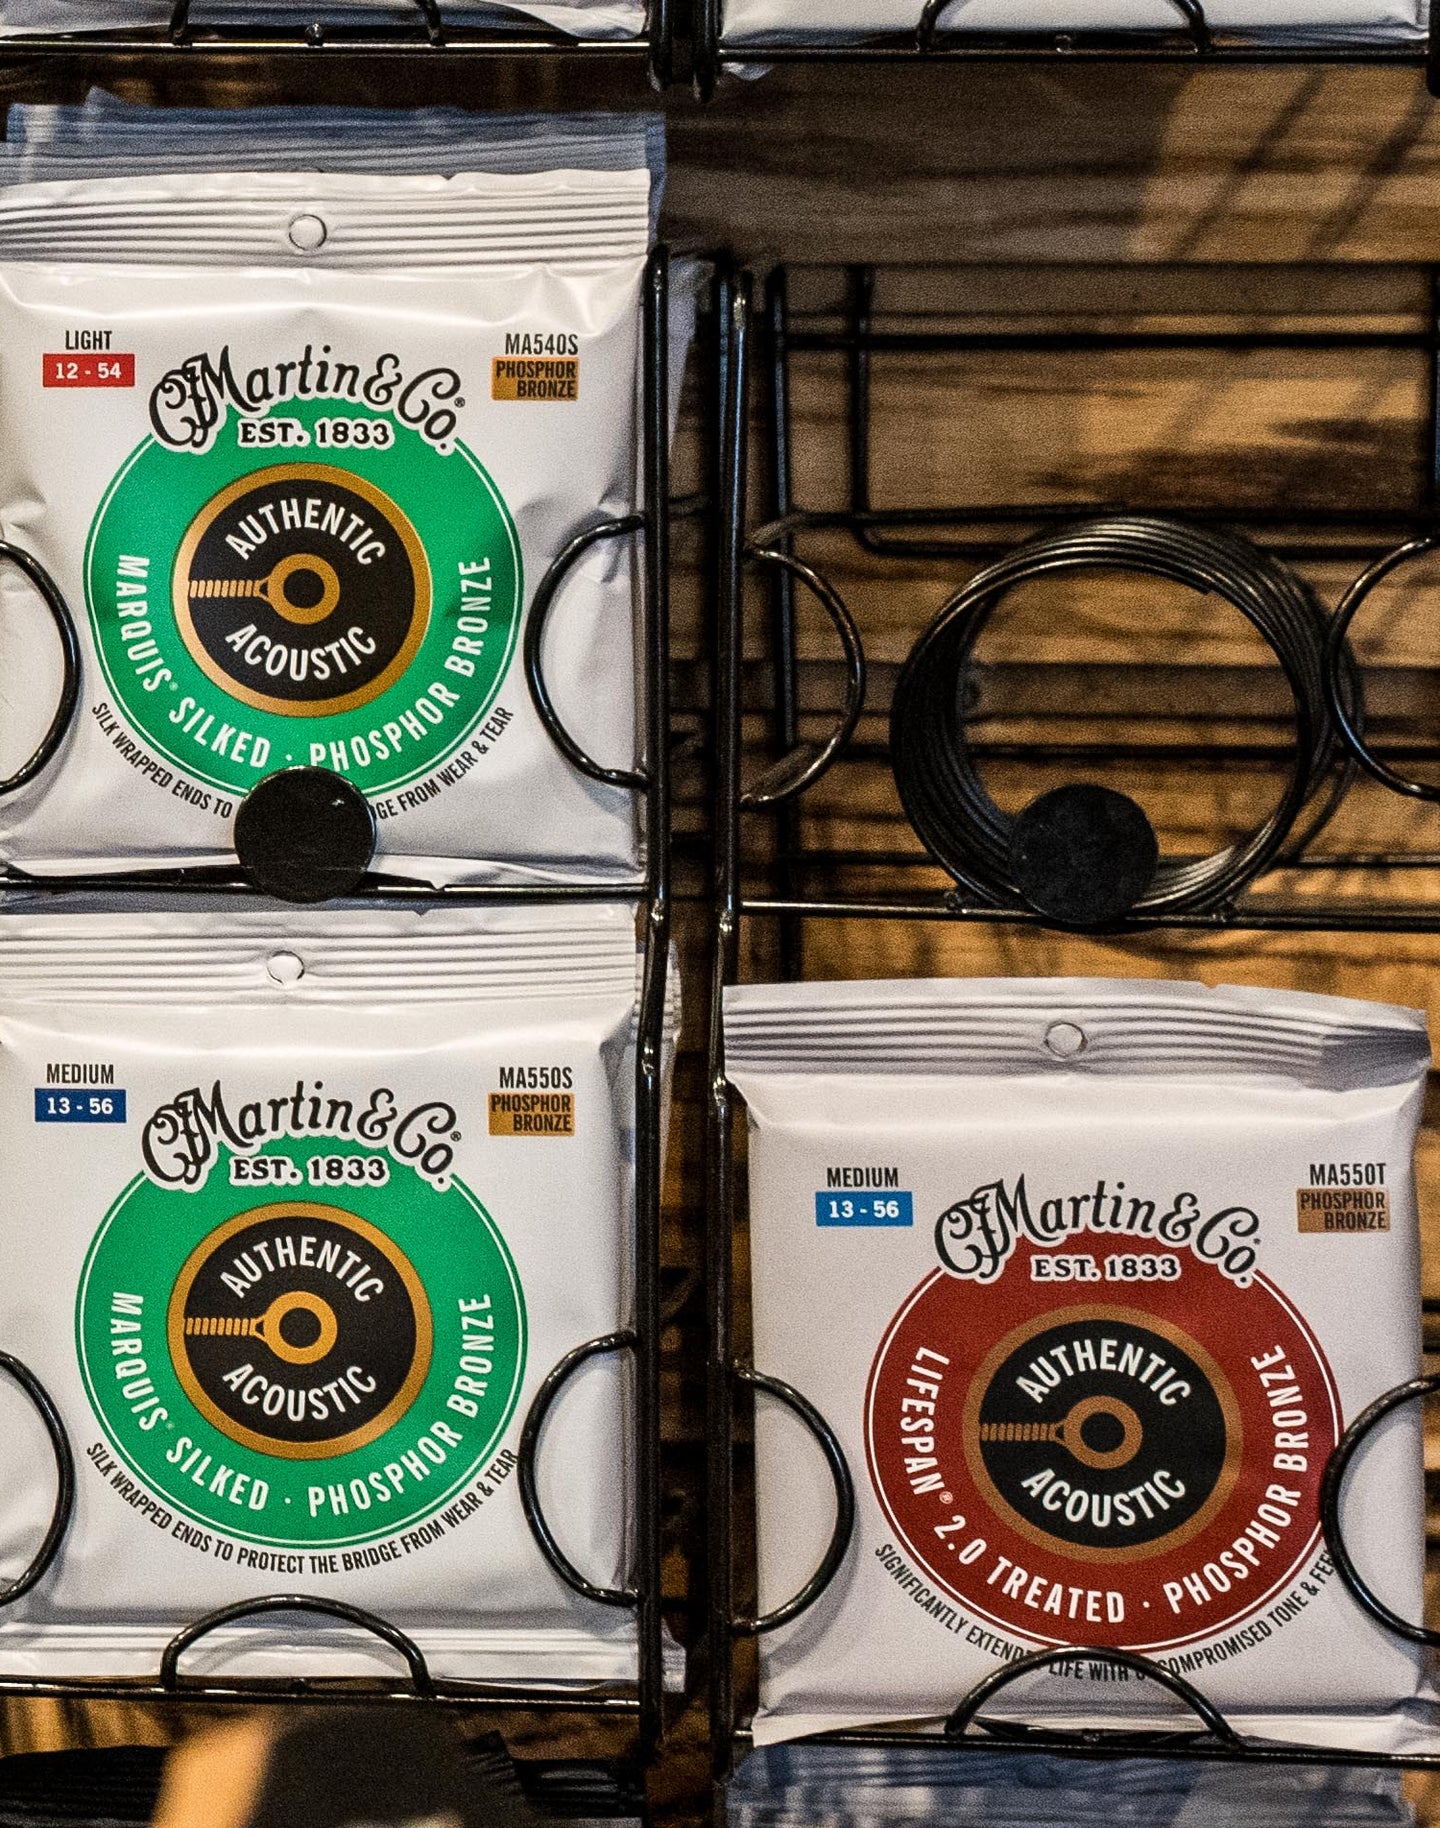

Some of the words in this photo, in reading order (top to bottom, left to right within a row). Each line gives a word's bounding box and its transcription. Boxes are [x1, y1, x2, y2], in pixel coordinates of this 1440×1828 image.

[65, 330, 113, 350] LIGHT
[505, 333, 579, 356] MA540S
[55, 362, 78, 380] 12
[98, 362, 122, 380] 54
[495, 360, 577, 379] PHOSPHOR
[516, 379, 577, 398] BRONZE
[240, 421, 305, 444] EST.
[318, 421, 390, 445] 1833
[225, 498, 385, 565] AUTHENTIC
[225, 623, 376, 681] ACOUSTIC
[169, 697, 271, 768] SILKED
[309, 681, 460, 773] PHOSPHOR
[444, 556, 492, 678] BRONZE
[91, 702, 120, 737] SILK
[112, 731, 173, 788] WRAPPED
[171, 779, 212, 810] ENDS
[212, 798, 233, 819] TO
[396, 778, 442, 812] FROM
[436, 750, 478, 787] WEAR
[480, 706, 514, 742] TEAR
[46, 1063, 114, 1085] MEDIUM
[499, 1067, 573, 1089] MA550S
[47, 1098, 70, 1115] 13
[88, 1098, 114, 1115] 56
[491, 1094, 572, 1114] PHOSPHOR
[513, 1114, 572, 1133] BRONZE
[233, 1158, 298, 1180] EST.
[310, 1158, 386, 1181] 1833
[827, 1167, 899, 1188] MEDIUM
[1309, 1163, 1386, 1186] MA550T
[829, 1201, 853, 1219] 13
[873, 1201, 899, 1219] 56
[1300, 1191, 1385, 1210] PHOSPHOR
[1324, 1211, 1386, 1230] BRONZE
[219, 1236, 384, 1303] AUTHENTIC
[1034, 1257, 1099, 1279] EST.
[1107, 1256, 1178, 1279] 1833
[1015, 1338, 1191, 1406] AUTHENTIC
[222, 1363, 377, 1422] ACOUSTIC
[166, 1437, 269, 1511] SILKED
[308, 1420, 463, 1517] PHOSPHOR
[447, 1294, 495, 1419] BRONZE
[87, 1442, 118, 1477] SILK
[484, 1448, 518, 1485] TEAR
[476, 1481, 494, 1497] &
[934, 1514, 987, 1567] 2.0
[986, 1555, 1125, 1623] TREATED
[1163, 1483, 1302, 1614] PHOSPHOR
[1251, 1343, 1309, 1474] BRONZE
[110, 1471, 173, 1530] WRAPPED
[441, 1491, 483, 1528] WEAR
[1021, 1467, 1187, 1528] ACOUSTIC
[171, 1520, 212, 1552] ENDS
[400, 1519, 445, 1553] FROM
[214, 1539, 233, 1561] TO
[237, 1547, 305, 1574] PROTECT
[342, 1540, 402, 1571] BRIDGE
[309, 1555, 339, 1574] THE
[875, 1543, 967, 1634] SIGNIFICANTLY
[1048, 1661, 1084, 1680] LIFE
[1089, 1661, 1129, 1682] WITH
[1267, 1590, 1309, 1628] TONE
[1300, 1581, 1320, 1597] &
